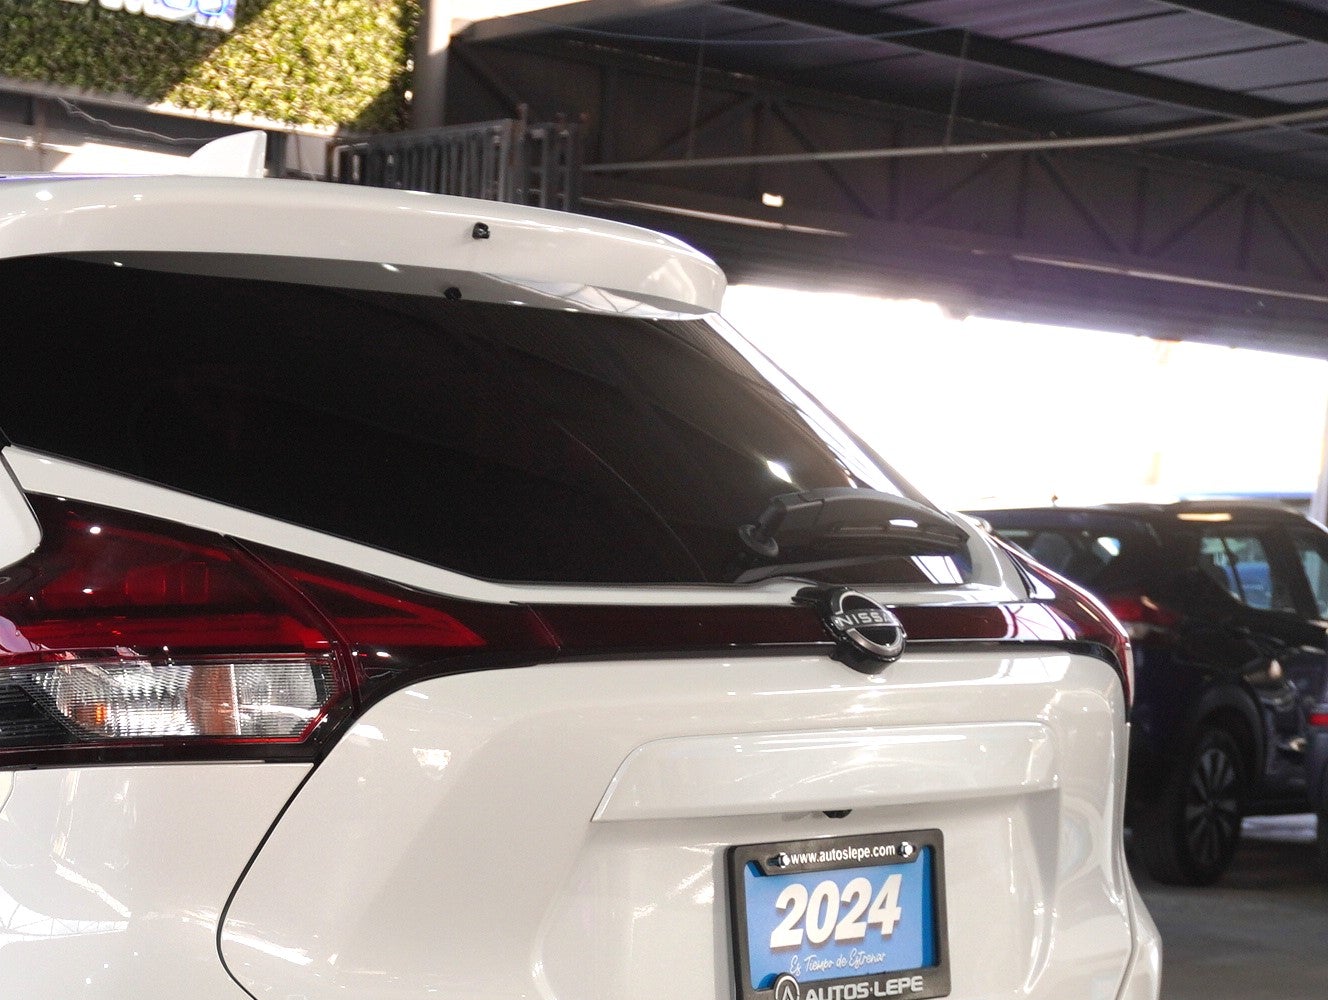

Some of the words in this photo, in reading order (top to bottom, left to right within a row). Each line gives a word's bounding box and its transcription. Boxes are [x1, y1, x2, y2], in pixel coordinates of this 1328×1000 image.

[790, 844, 896, 865] www.autoslepe.com
[770, 873, 903, 949] 2024
[789, 954, 802, 978] Es
[804, 954, 834, 972] Tiempo
[836, 953, 848, 969] de
[848, 947, 886, 969] Estrenar
